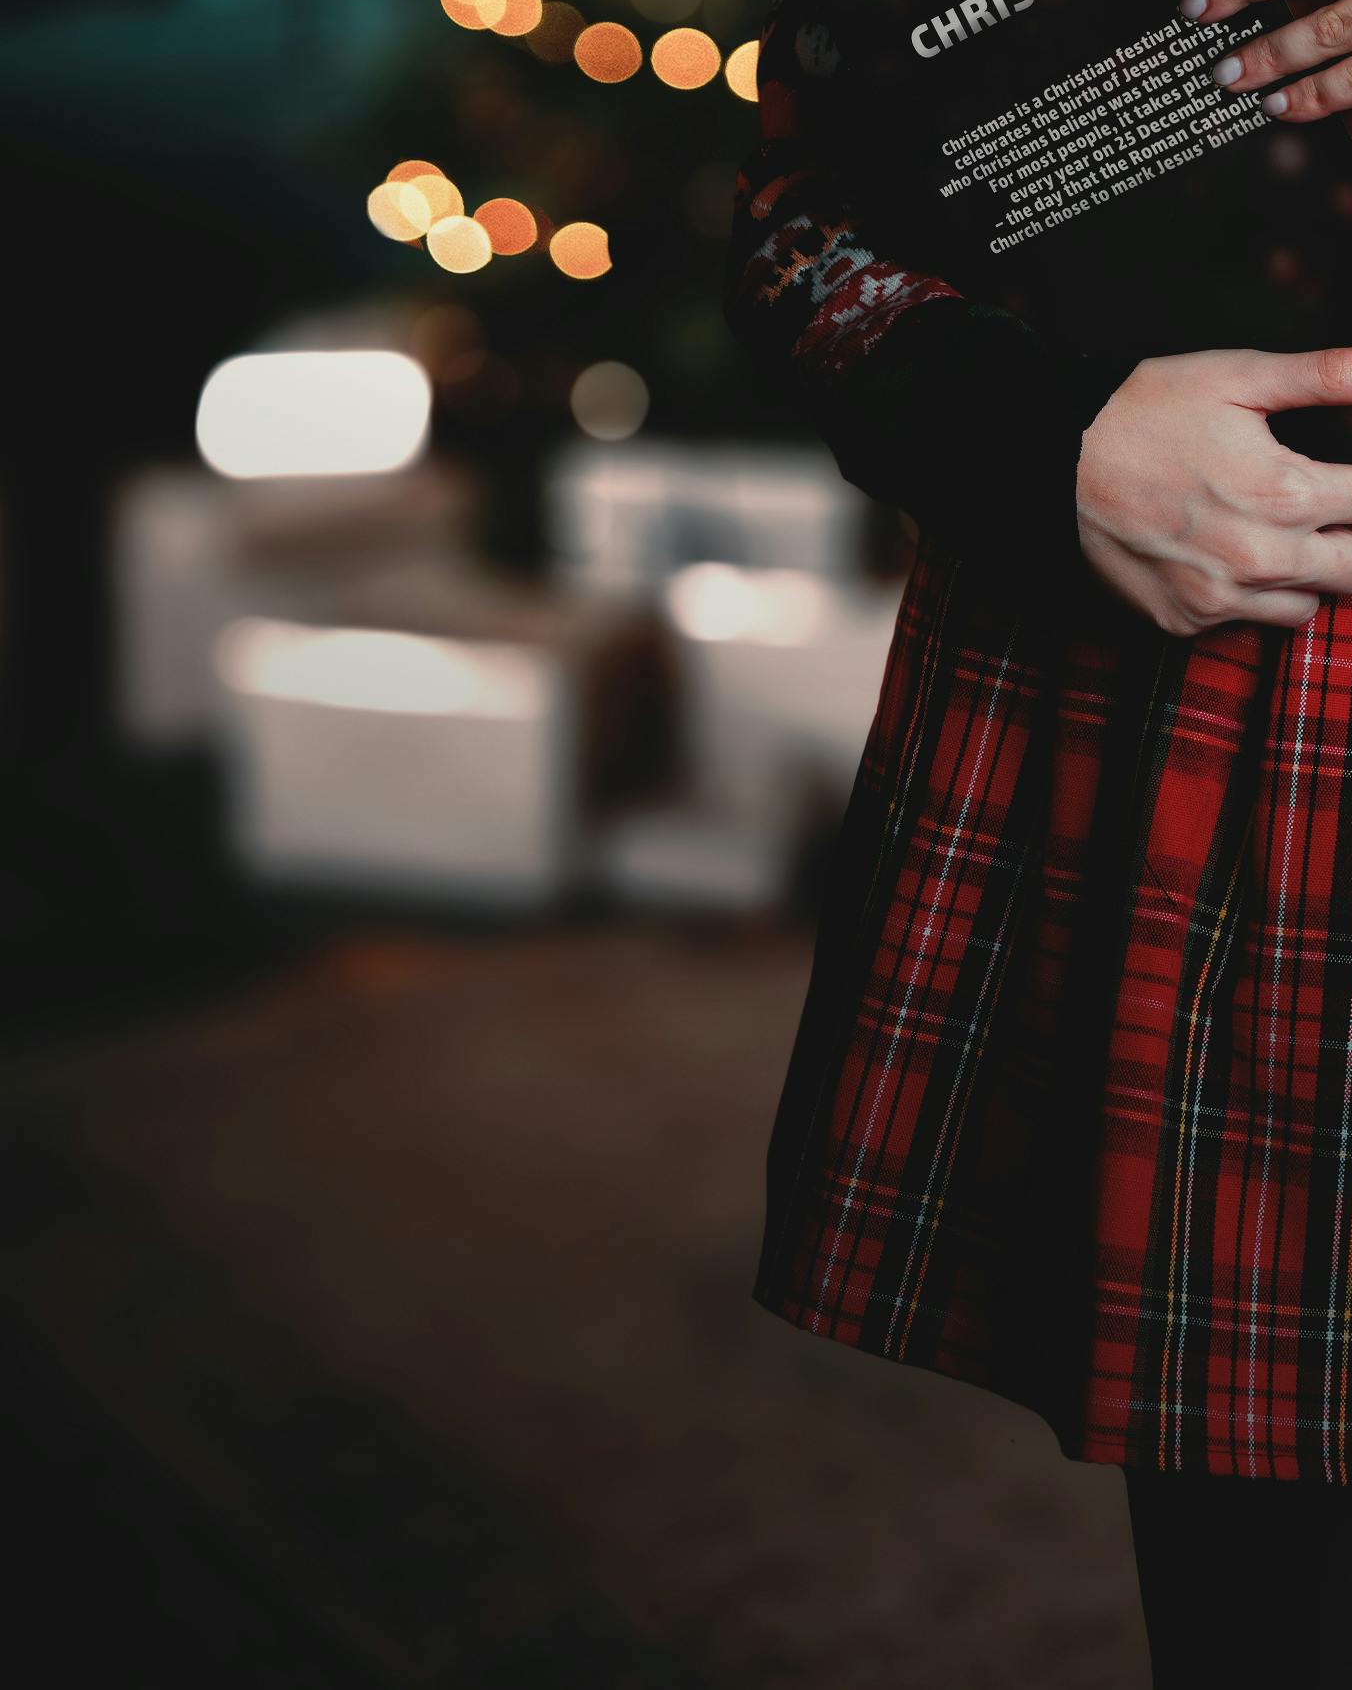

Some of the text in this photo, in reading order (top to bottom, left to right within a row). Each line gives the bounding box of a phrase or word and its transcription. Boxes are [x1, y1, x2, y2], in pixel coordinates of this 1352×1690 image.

[939, 175, 972, 198] who
[972, 135, 1049, 181] Christians
[1047, 104, 1108, 142] believe
[1107, 87, 1142, 111] was
[1141, 71, 1173, 93] the
[1173, 53, 1206, 78] son
[941, 19, 1182, 156] Christmas is a Christian festival
[954, 22, 1230, 170] celebrates the birth of Jesus Christ,
[988, 73, 1212, 194] For most people, it takes pla
[1010, 89, 1222, 203] every year on 25 December
[989, 110, 1272, 254] Church chose to mark Jesus' birthd
[1005, 205, 1034, 226] the
[1034, 190, 1064, 212] day
[1063, 171, 1100, 197] that
[1099, 157, 1130, 180] the
[1128, 129, 1190, 166] Roman
[1189, 92, 1261, 135] Catholic
